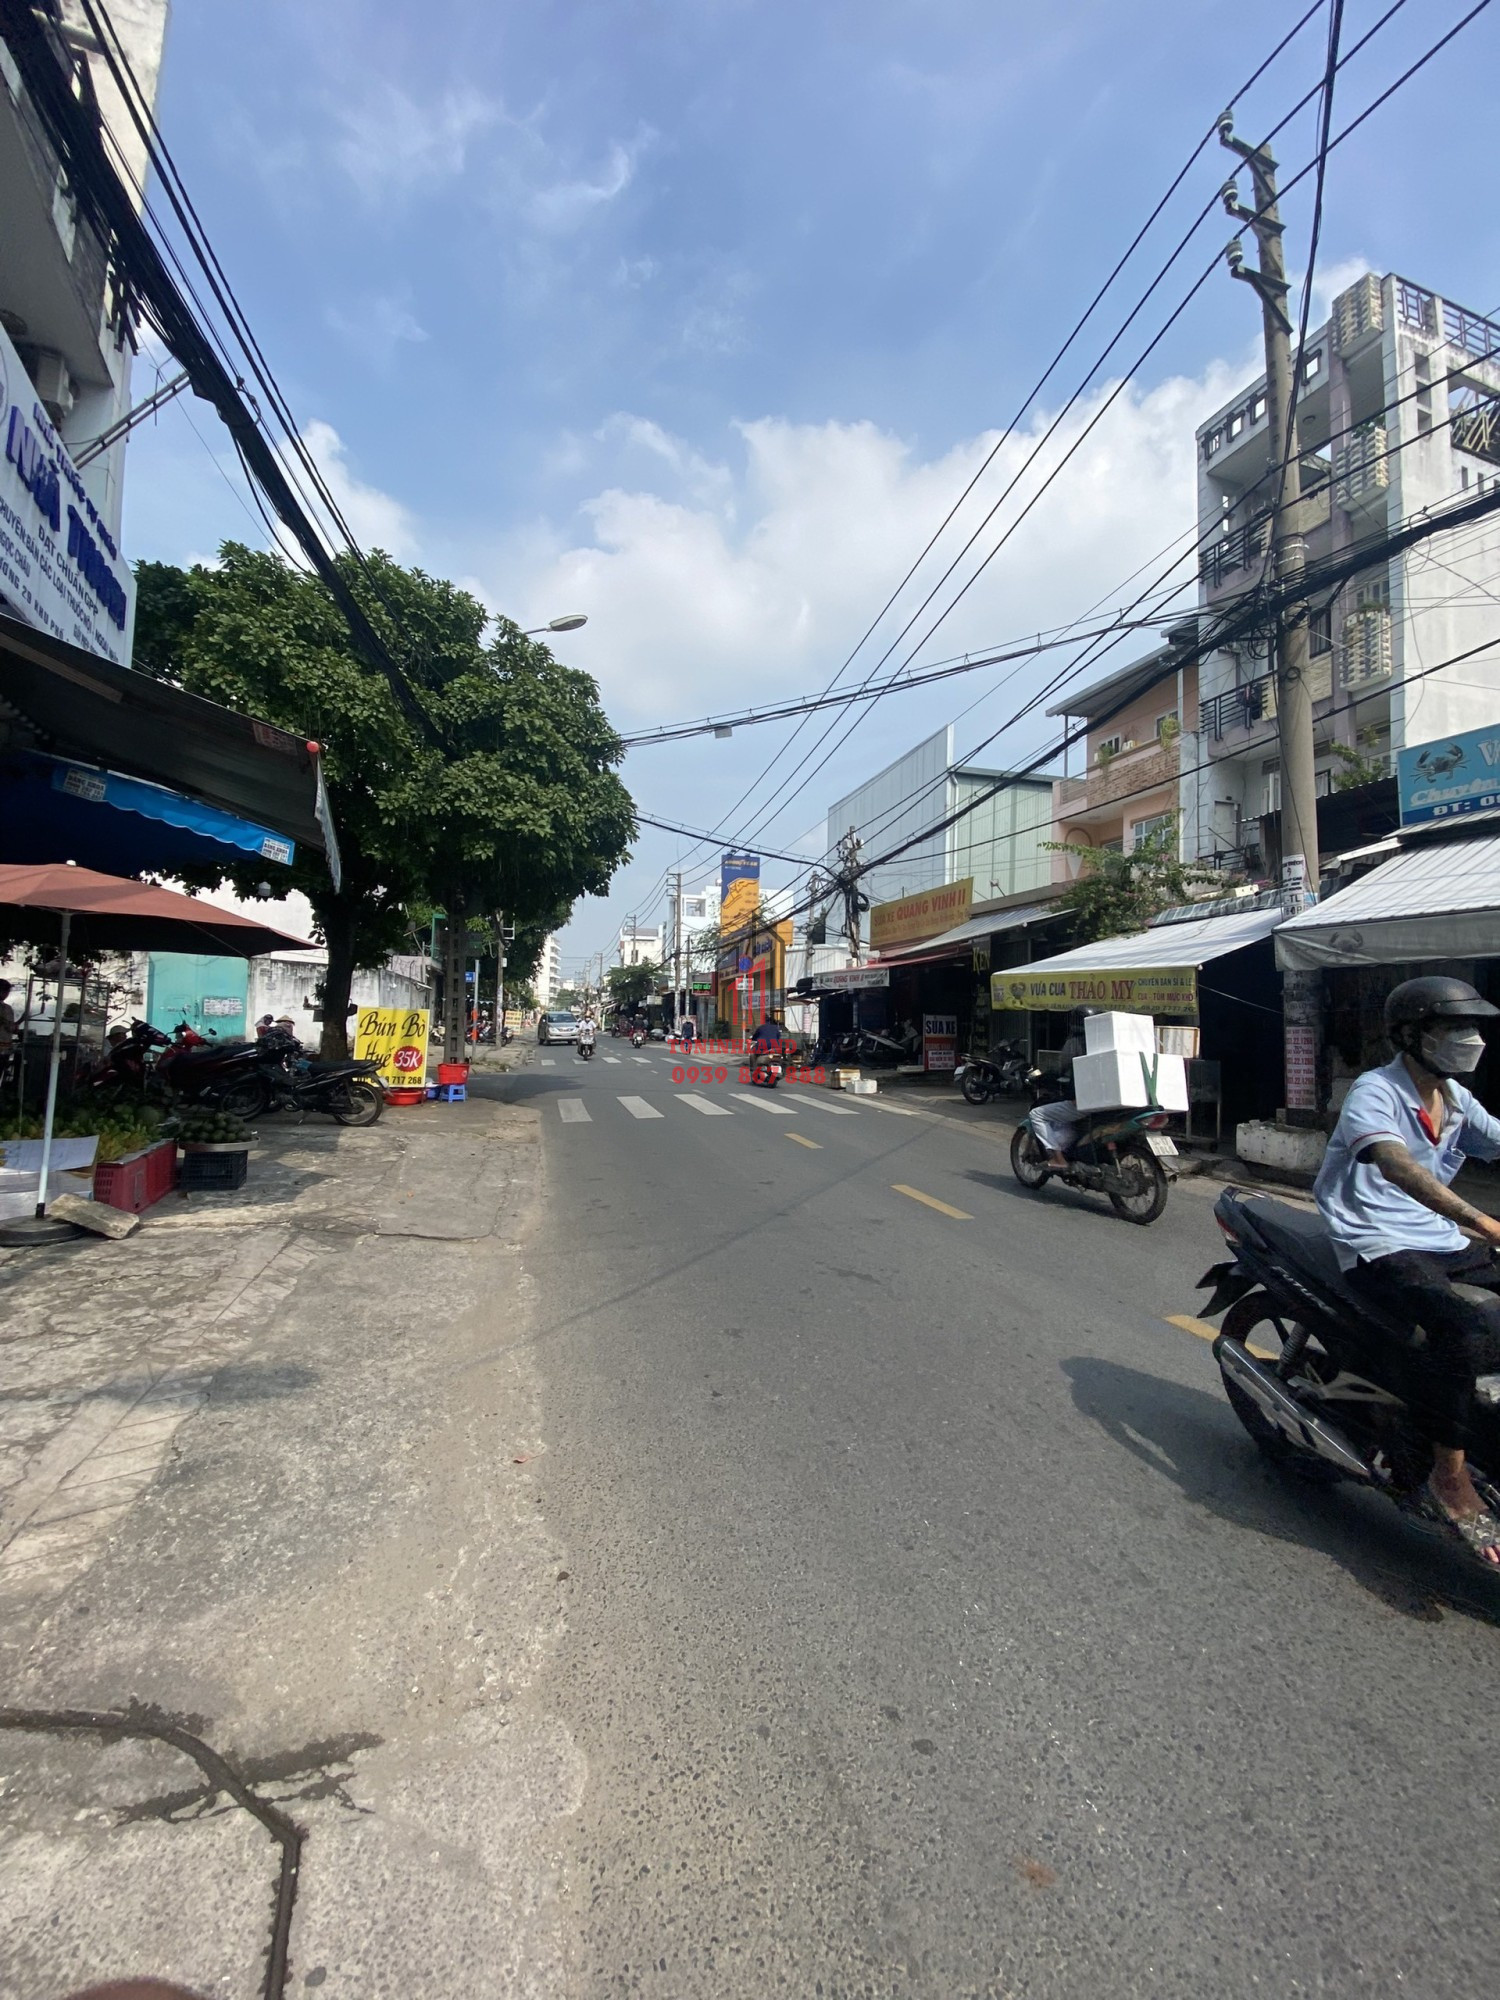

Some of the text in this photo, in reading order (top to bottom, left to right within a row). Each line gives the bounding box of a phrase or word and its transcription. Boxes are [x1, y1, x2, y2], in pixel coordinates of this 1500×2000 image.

[38, 523, 56, 557] ĐẠT
[56, 552, 85, 600] CHUẨN
[84, 592, 99, 616] GPP
[896, 900, 929, 921] QUANG
[932, 891, 956, 912] VINH
[1049, 982, 1066, 996] CUA
[1068, 973, 1106, 1000] THẢO
[359, 1011, 426, 1039] Bún Bò
[395, 1051, 422, 1068] 35K
[392, 1075, 406, 1085] 717
[408, 1075, 422, 1085] 268
